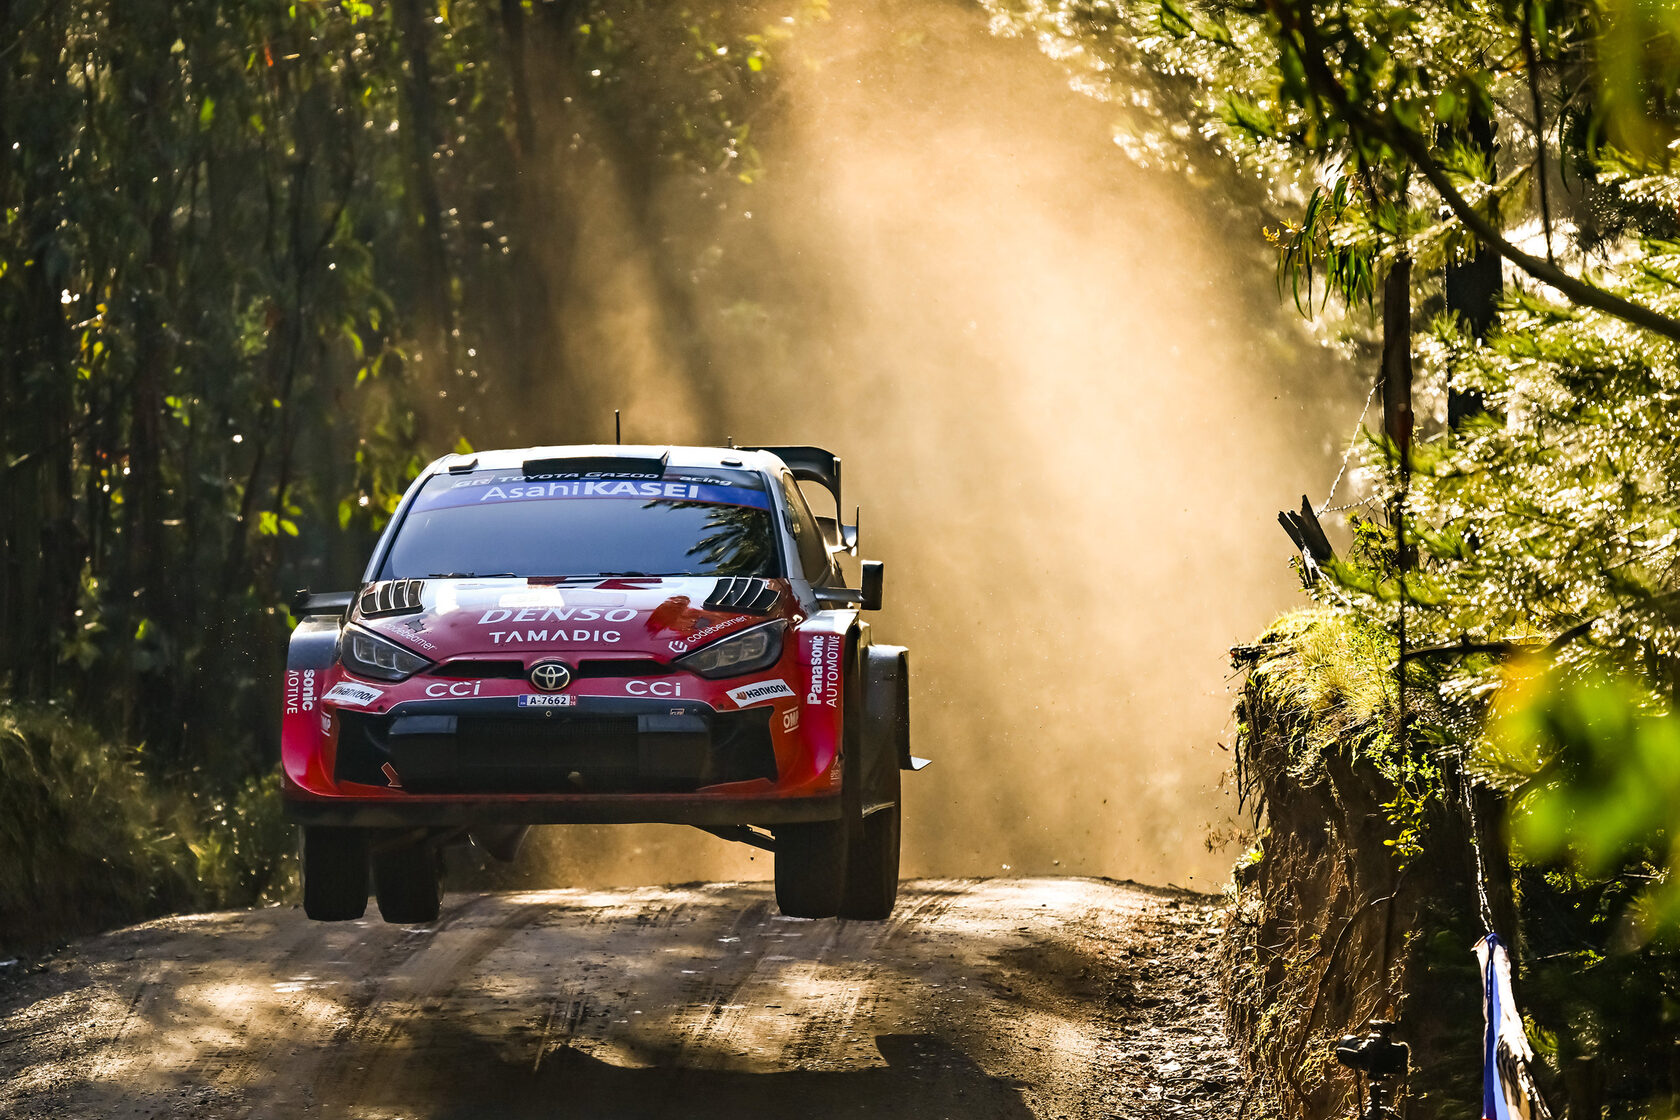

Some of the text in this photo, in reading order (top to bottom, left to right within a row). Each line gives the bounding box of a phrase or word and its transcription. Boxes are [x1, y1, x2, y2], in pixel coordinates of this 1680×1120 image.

[498, 472, 579, 482] TOYOTA
[584, 471, 660, 480] GAZOO
[679, 475, 733, 486] acing
[477, 608, 639, 625] DENSO
[489, 629, 621, 644] TAMADIC
[686, 615, 748, 643] codebeamer
[806, 635, 825, 705] Panasonic
[826, 635, 840, 708] AUTOMOTIVE
[302, 669, 318, 711] sonic
[530, 696, 567, 705] A-7662
